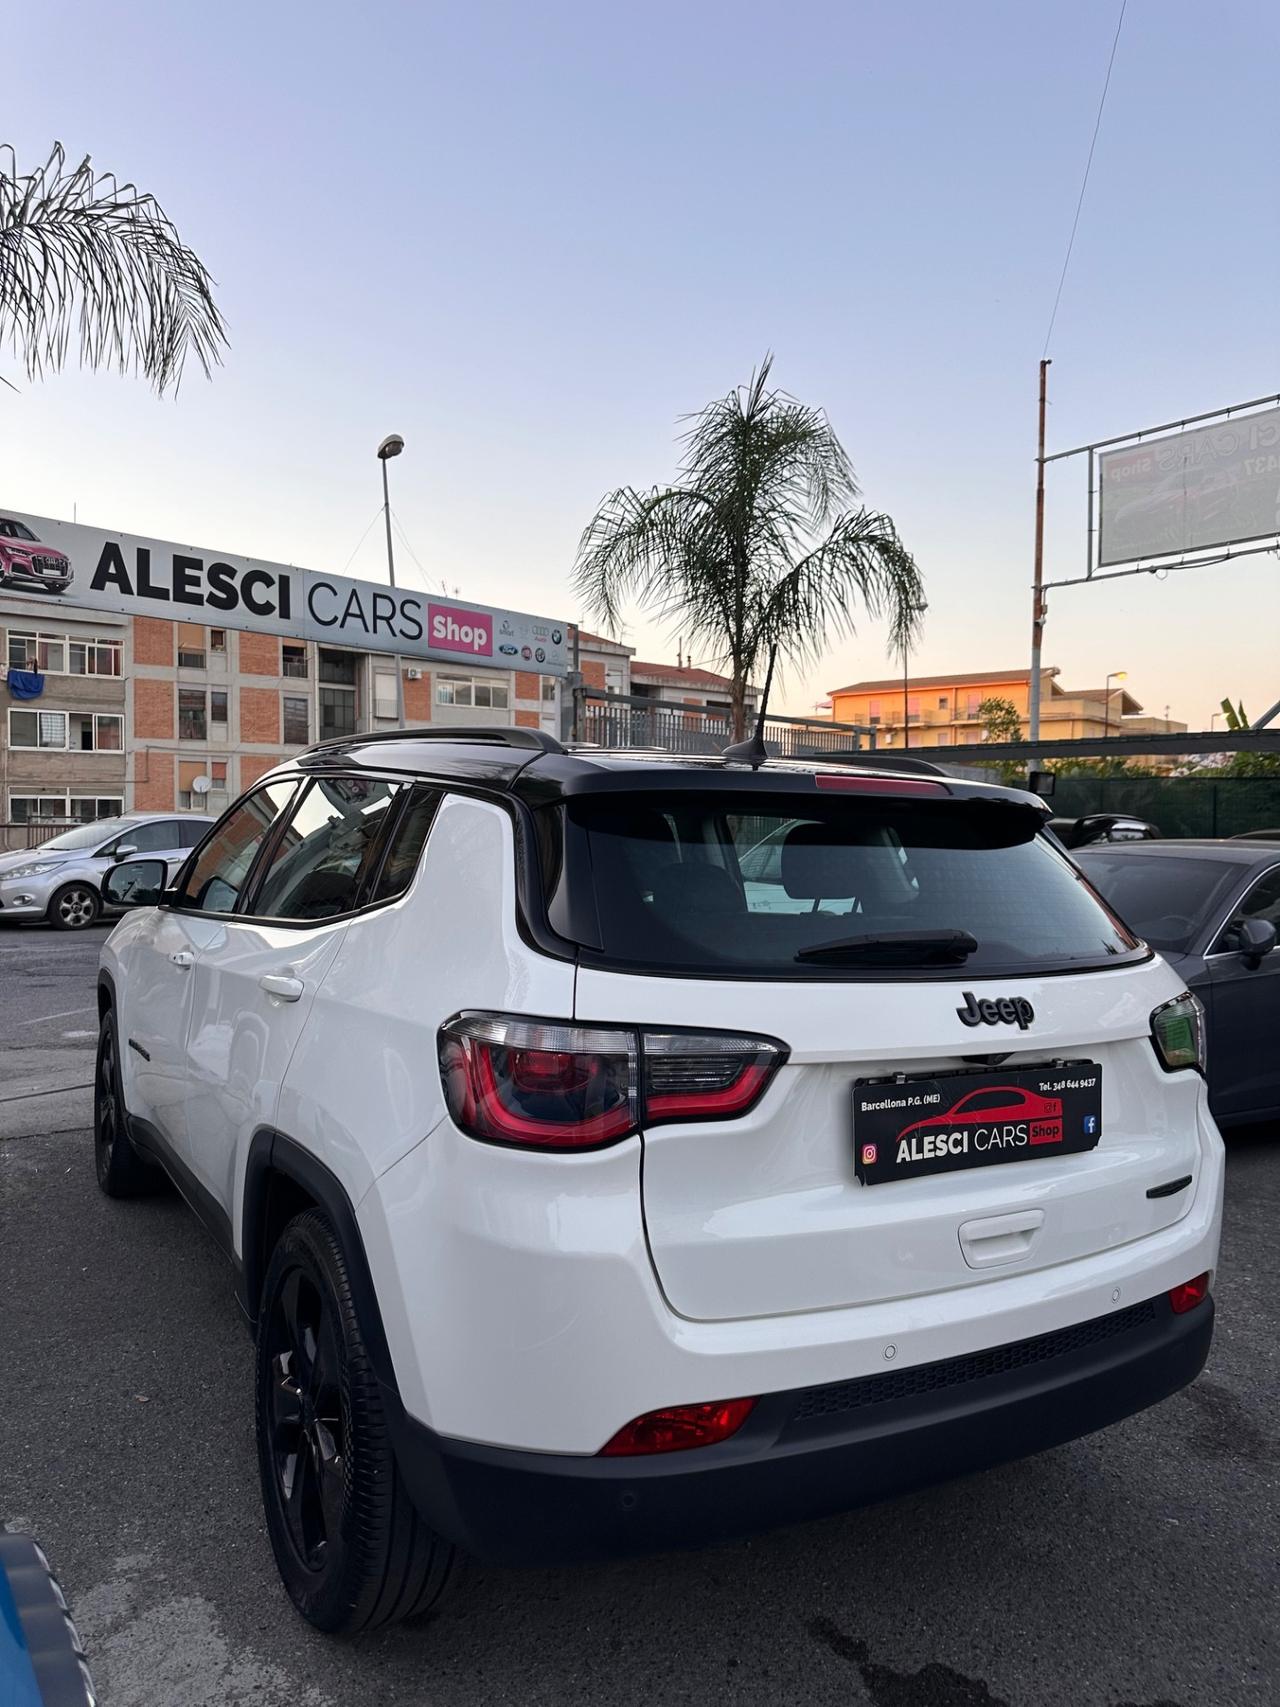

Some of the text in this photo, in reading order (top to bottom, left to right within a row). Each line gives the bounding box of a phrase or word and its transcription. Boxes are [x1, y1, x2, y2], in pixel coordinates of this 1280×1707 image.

[90, 541, 488, 650] ALESCI CARS Shop
[956, 991, 1035, 1030] Jeep
[861, 1094, 941, 1112] Barcellona P.G. (ME)
[1053, 1080, 1065, 1091] 348
[1066, 1079, 1079, 1088] 644
[1080, 1078, 1096, 1089] 9437
[896, 1123, 1060, 1163] ALESCI CARS Shop
